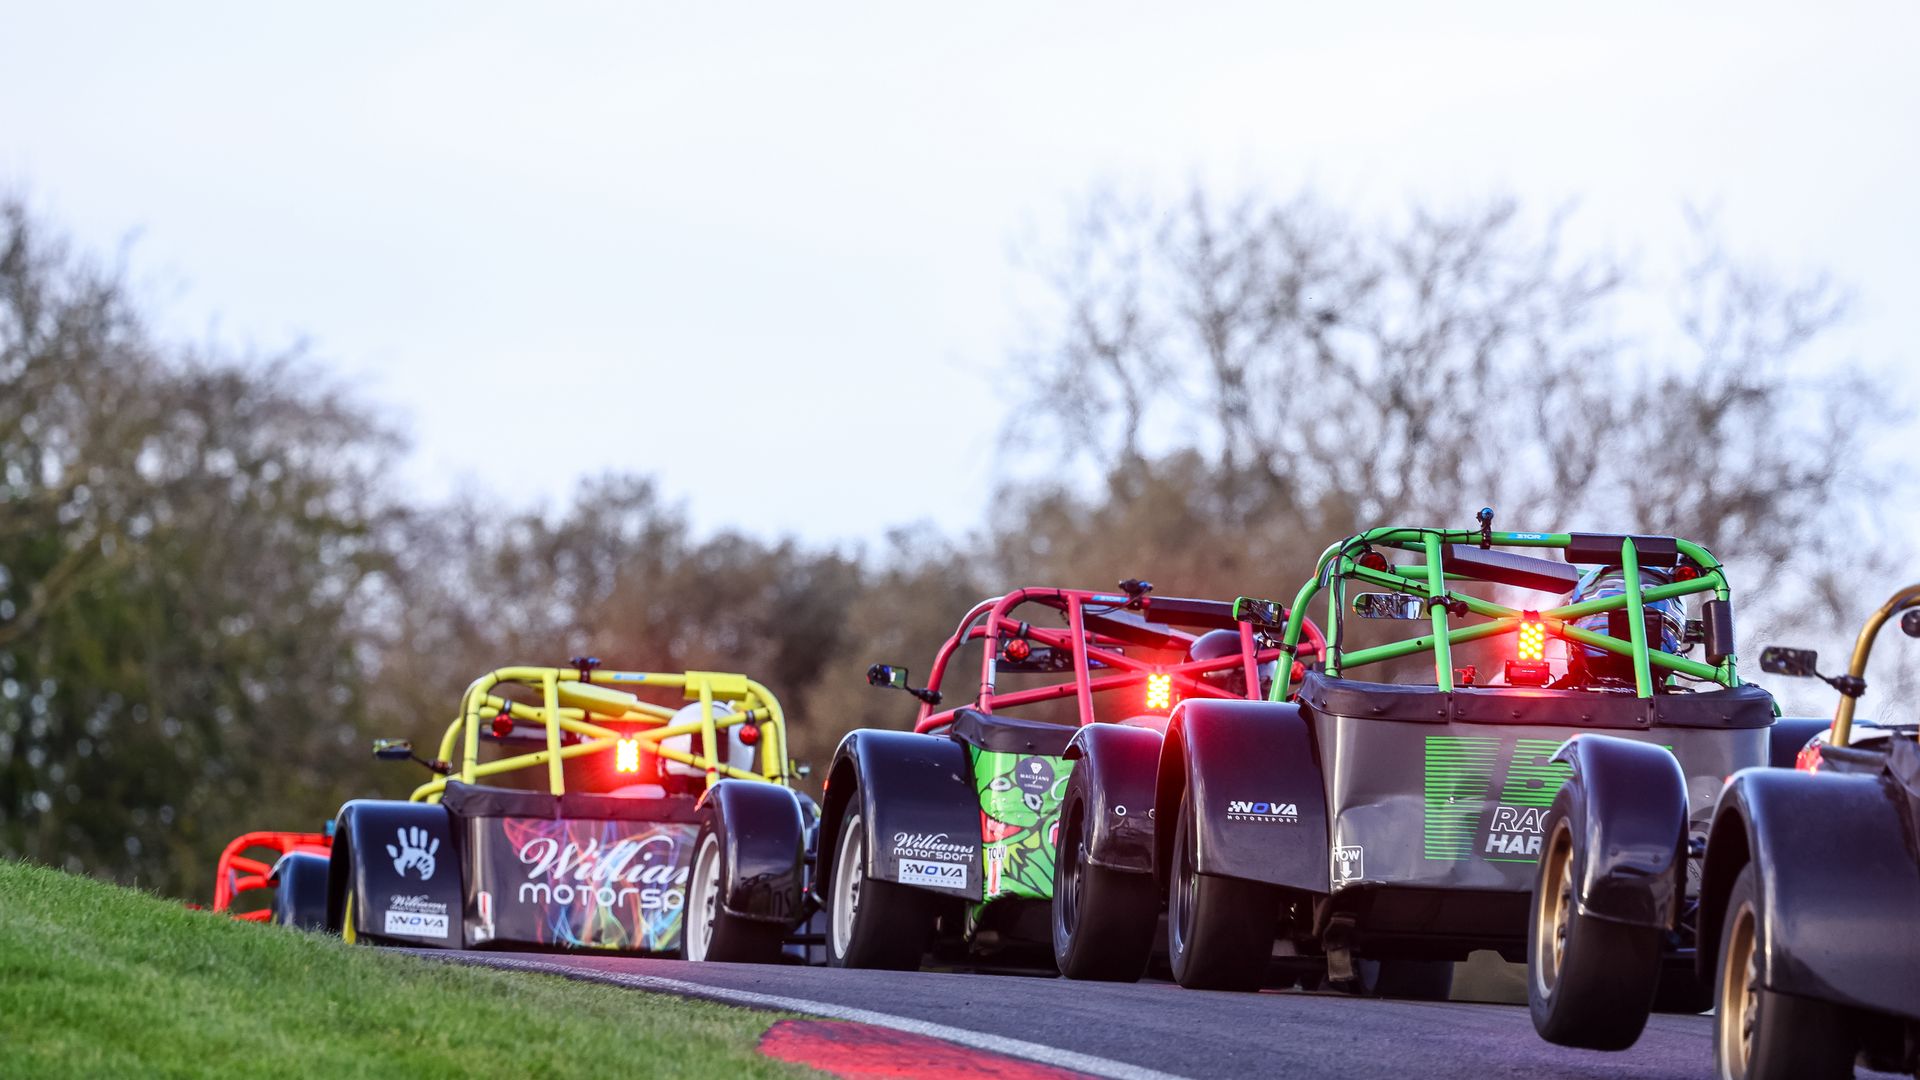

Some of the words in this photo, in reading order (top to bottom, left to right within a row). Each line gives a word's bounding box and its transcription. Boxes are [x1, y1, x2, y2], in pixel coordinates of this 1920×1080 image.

[1228, 800, 1298, 815] NOVA
[1227, 815, 1298, 823] MOTORSPORT
[894, 832, 974, 854] Williams
[1334, 850, 1360, 862] TOW
[903, 863, 963, 878] NOVA
[390, 915, 444, 928] NOVA
